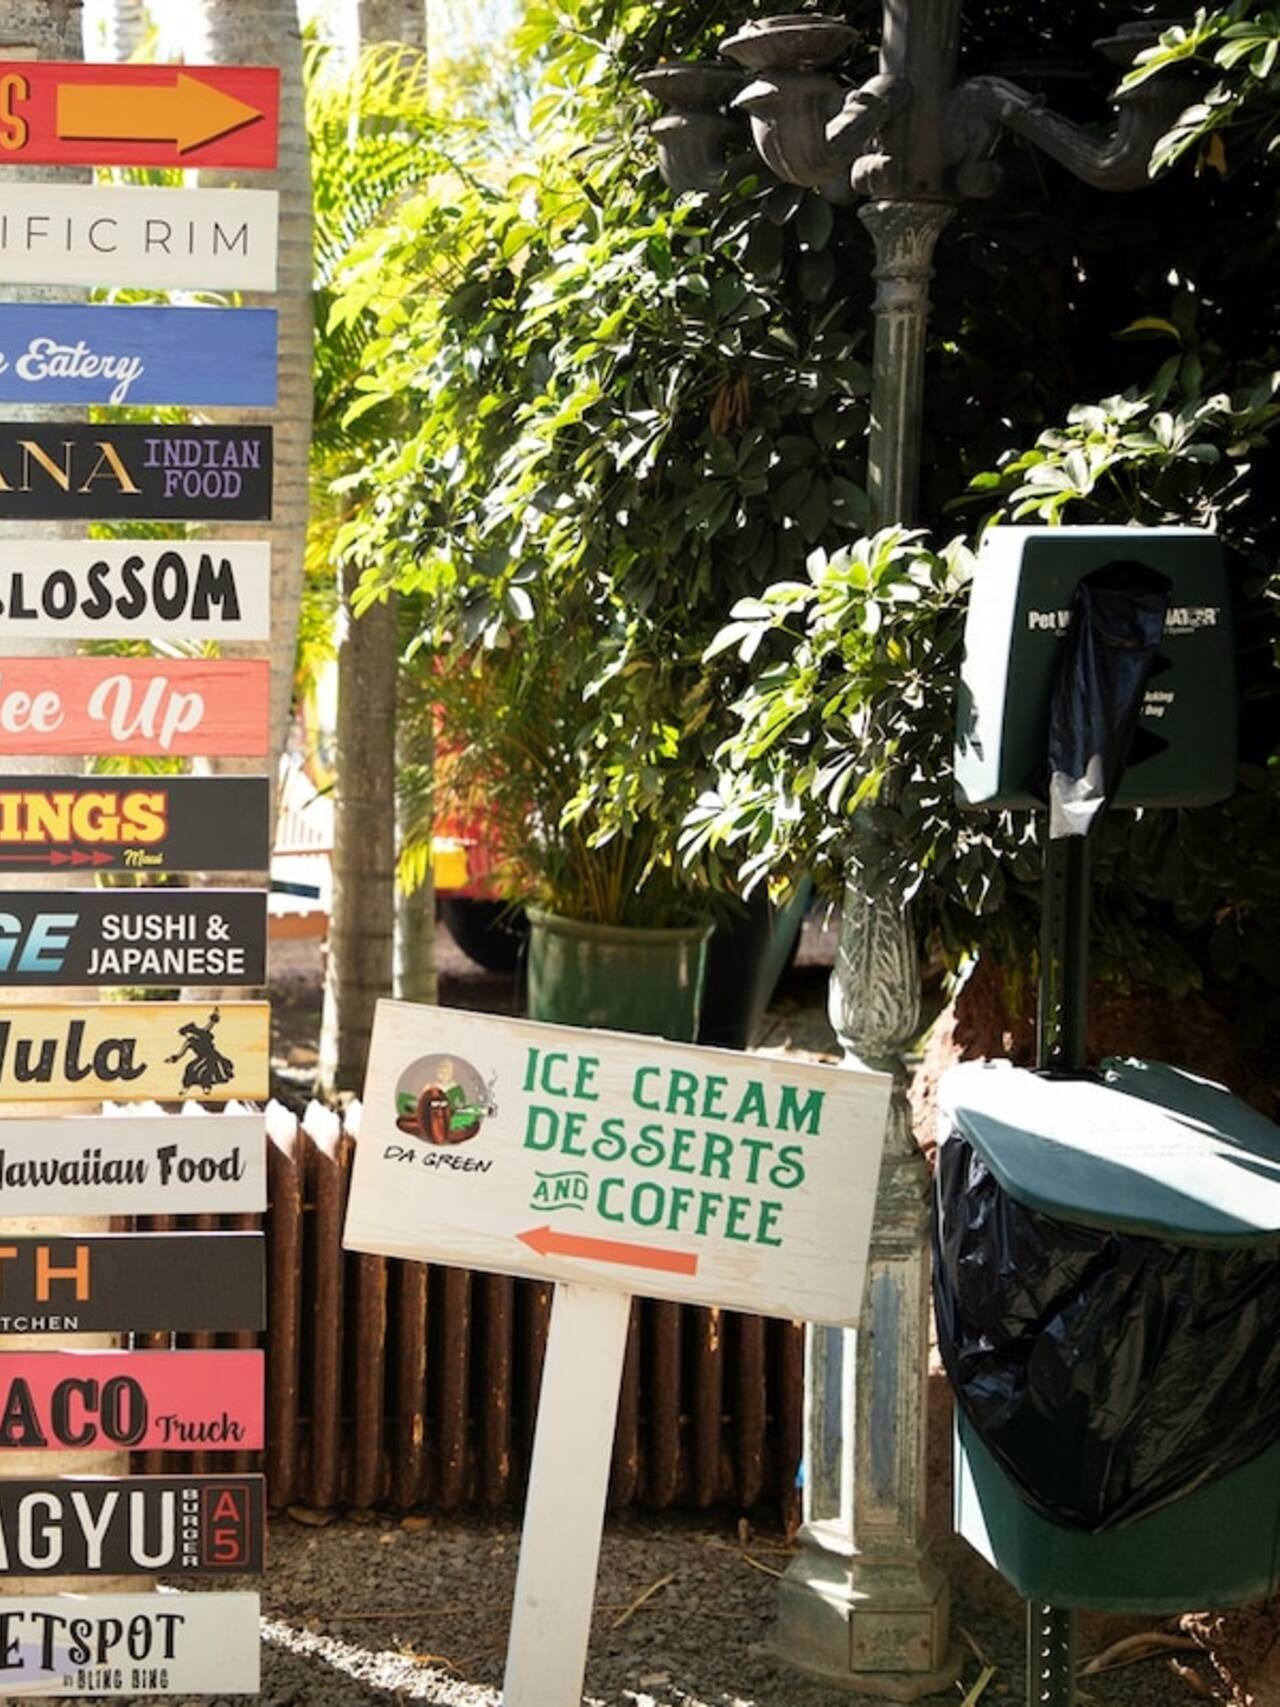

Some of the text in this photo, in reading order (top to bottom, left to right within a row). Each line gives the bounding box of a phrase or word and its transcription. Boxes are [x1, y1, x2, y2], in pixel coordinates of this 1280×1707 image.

[144, 219, 249, 256] RIM
[17, 338, 143, 405] Eatery
[143, 438, 260, 469] INDIAN
[163, 471, 241, 499] FOOD
[1029, 611, 1056, 629] Pet
[88, 675, 204, 749] Up
[123, 848, 163, 867] Maui
[101, 915, 194, 940] SUSHI
[208, 916, 230, 942] &
[86, 948, 244, 975] JAPANESE
[523, 1048, 826, 1136] ICE CREAM
[384, 1145, 493, 1174] DA GREEN
[523, 1105, 806, 1190] DESSERTS
[157, 1144, 246, 1186] Food
[532, 1173, 784, 1246] AND COFFEE
[156, 1415, 245, 1444] Truck
[182, 1489, 198, 1567] BURGER
[77, 1668, 122, 1690] BLING
